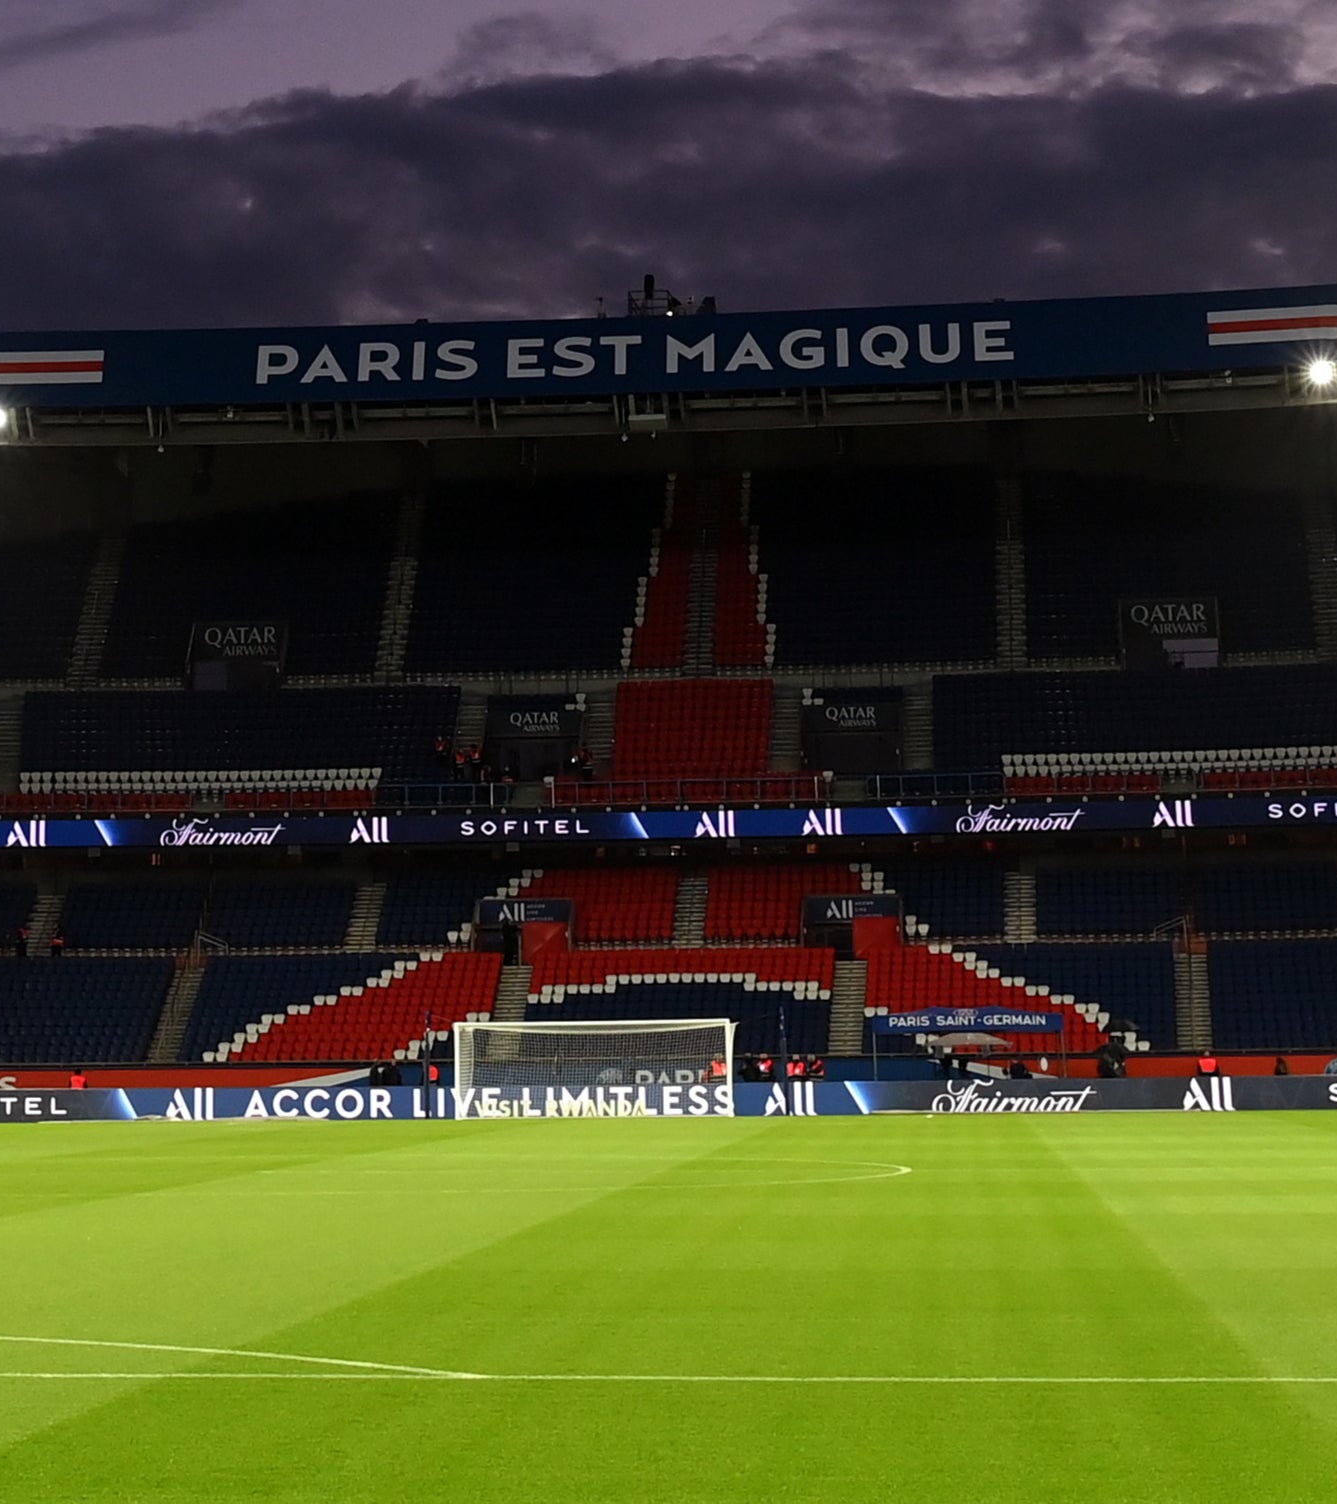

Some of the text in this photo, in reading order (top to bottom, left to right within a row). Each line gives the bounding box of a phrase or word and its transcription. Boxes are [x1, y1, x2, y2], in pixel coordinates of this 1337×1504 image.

[256, 320, 1015, 384] PARIS EST MAGIQUE
[1130, 604, 1206, 626] QATAR
[204, 627, 276, 648] QATAR
[1151, 623, 1208, 634] AIRWAYS
[222, 646, 277, 656] AIRWAYS
[509, 712, 559, 727] QATAR
[825, 707, 875, 722] QATAR
[461, 820, 588, 836] SOFITEL
[956, 805, 1084, 832] Fairmont
[160, 818, 285, 845] Fairmont
[889, 1015, 1046, 1027] PARIS SAINT-GERMAIN
[244, 1086, 733, 1118] ACCOR LIVE LIMITLESS
[931, 1079, 1096, 1113] Fairmont
[475, 1098, 649, 1117] VISIT RWANDA
